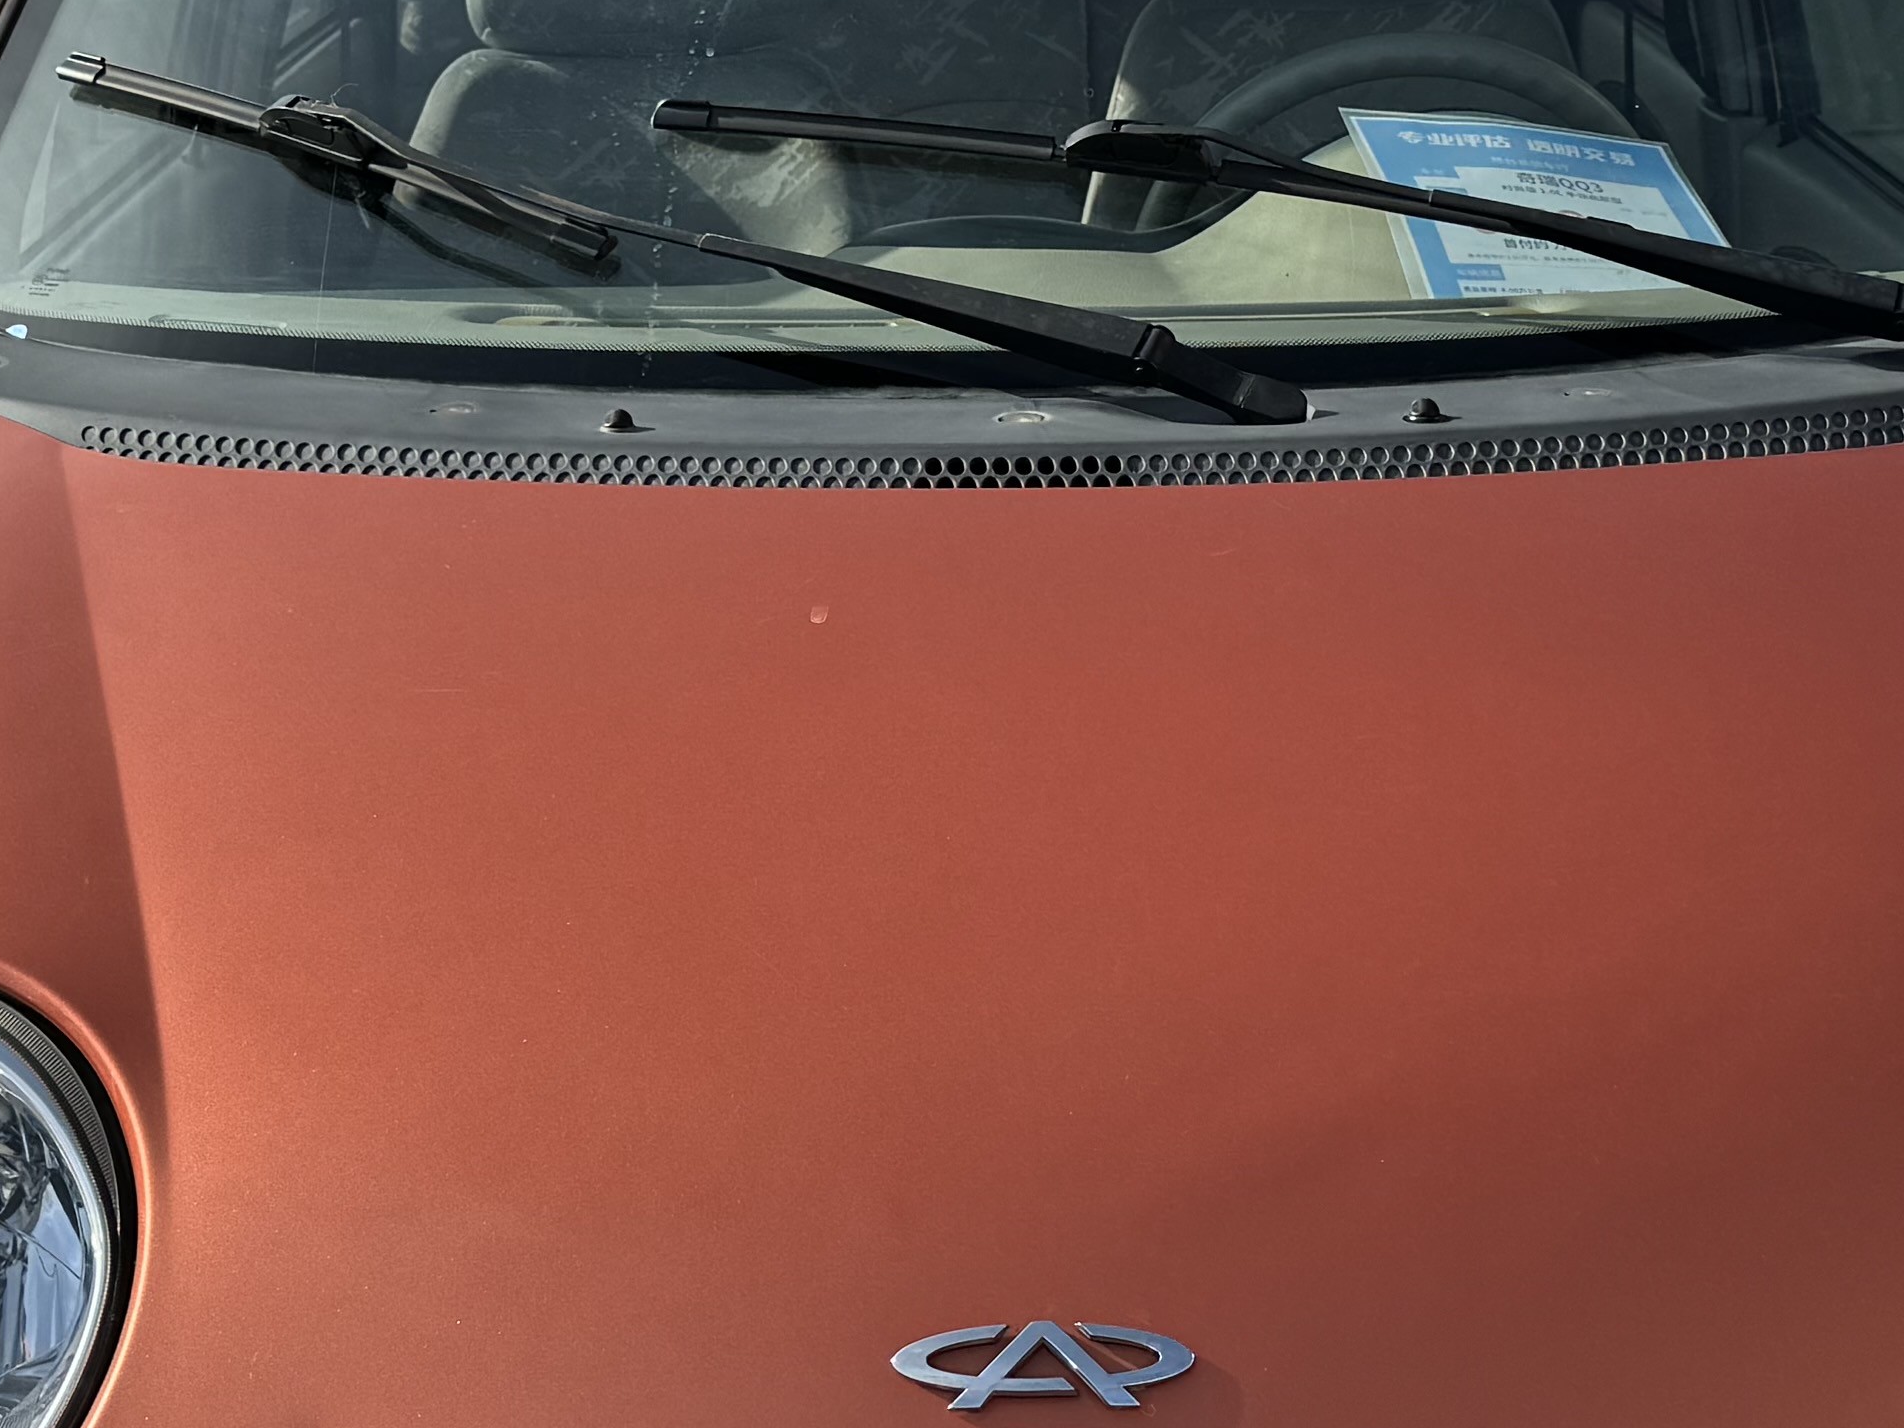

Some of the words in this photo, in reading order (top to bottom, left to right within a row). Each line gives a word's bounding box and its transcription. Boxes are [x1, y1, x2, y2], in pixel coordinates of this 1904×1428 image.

[1397, 130, 1512, 149] 专业评估
[1527, 138, 1636, 167] 透明交易
[1516, 172, 1604, 194] 奇瑞QQ3
